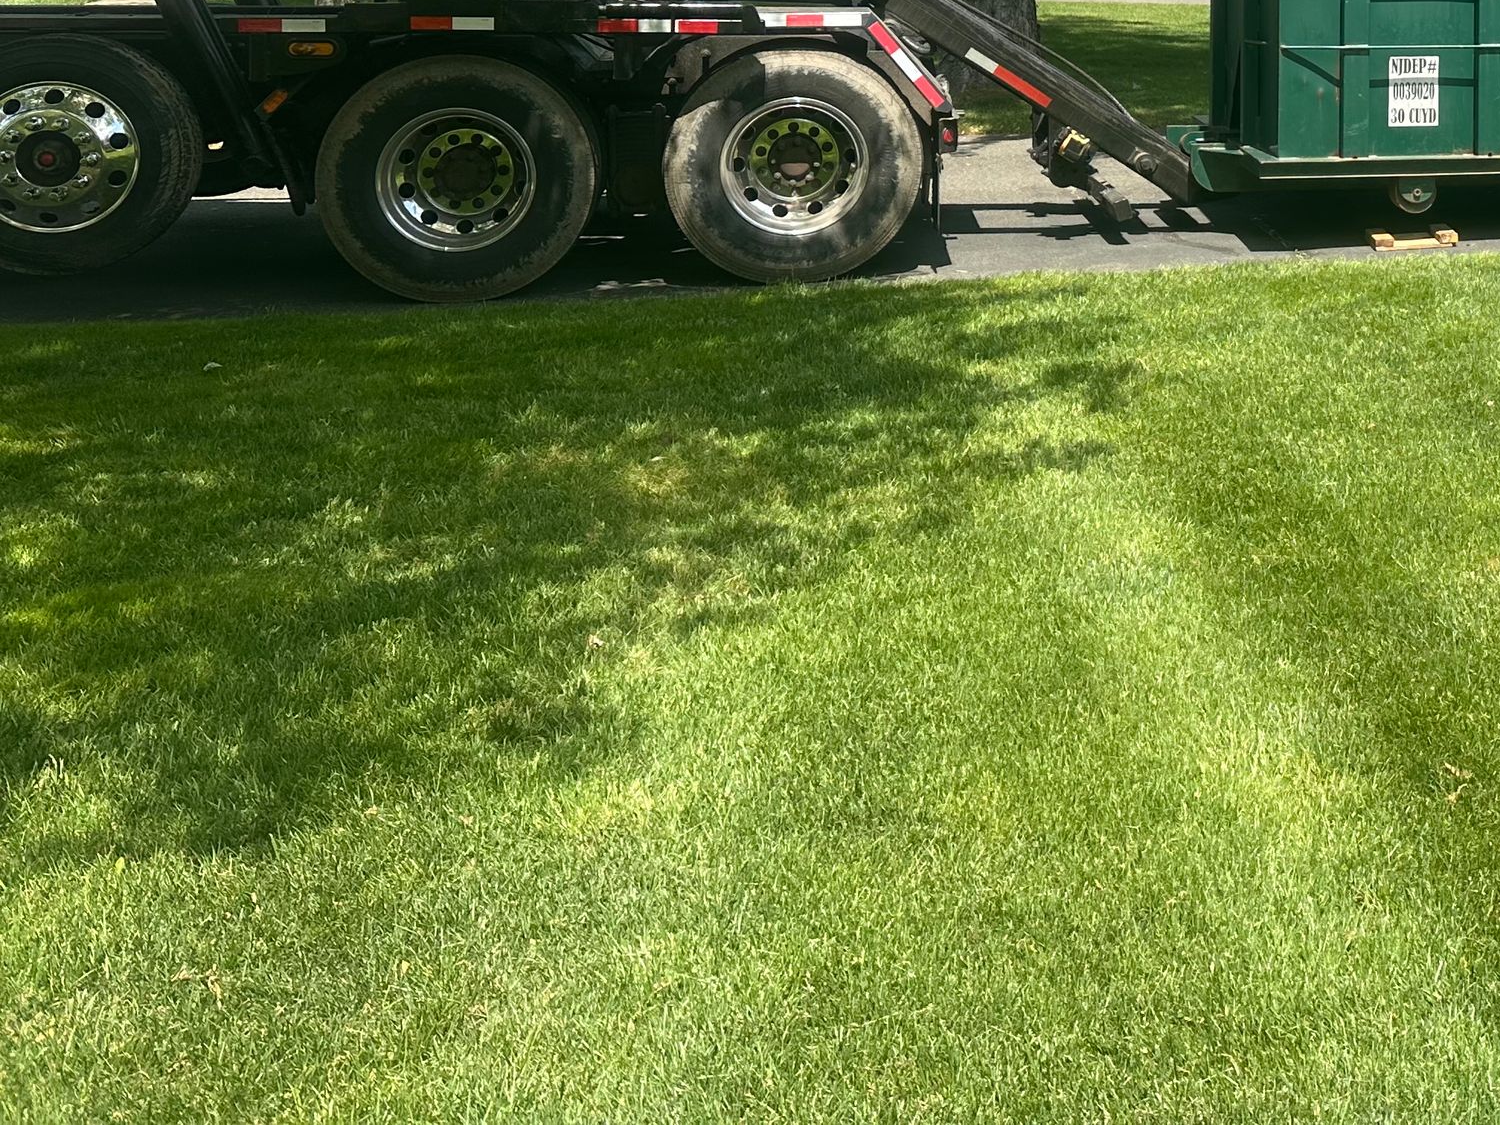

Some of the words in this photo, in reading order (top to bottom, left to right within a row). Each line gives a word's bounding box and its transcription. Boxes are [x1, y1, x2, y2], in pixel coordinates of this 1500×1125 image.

[1393, 82, 1435, 100] 0039020
[1391, 108, 1405, 124] 30
[1409, 108, 1436, 124] CUYD
